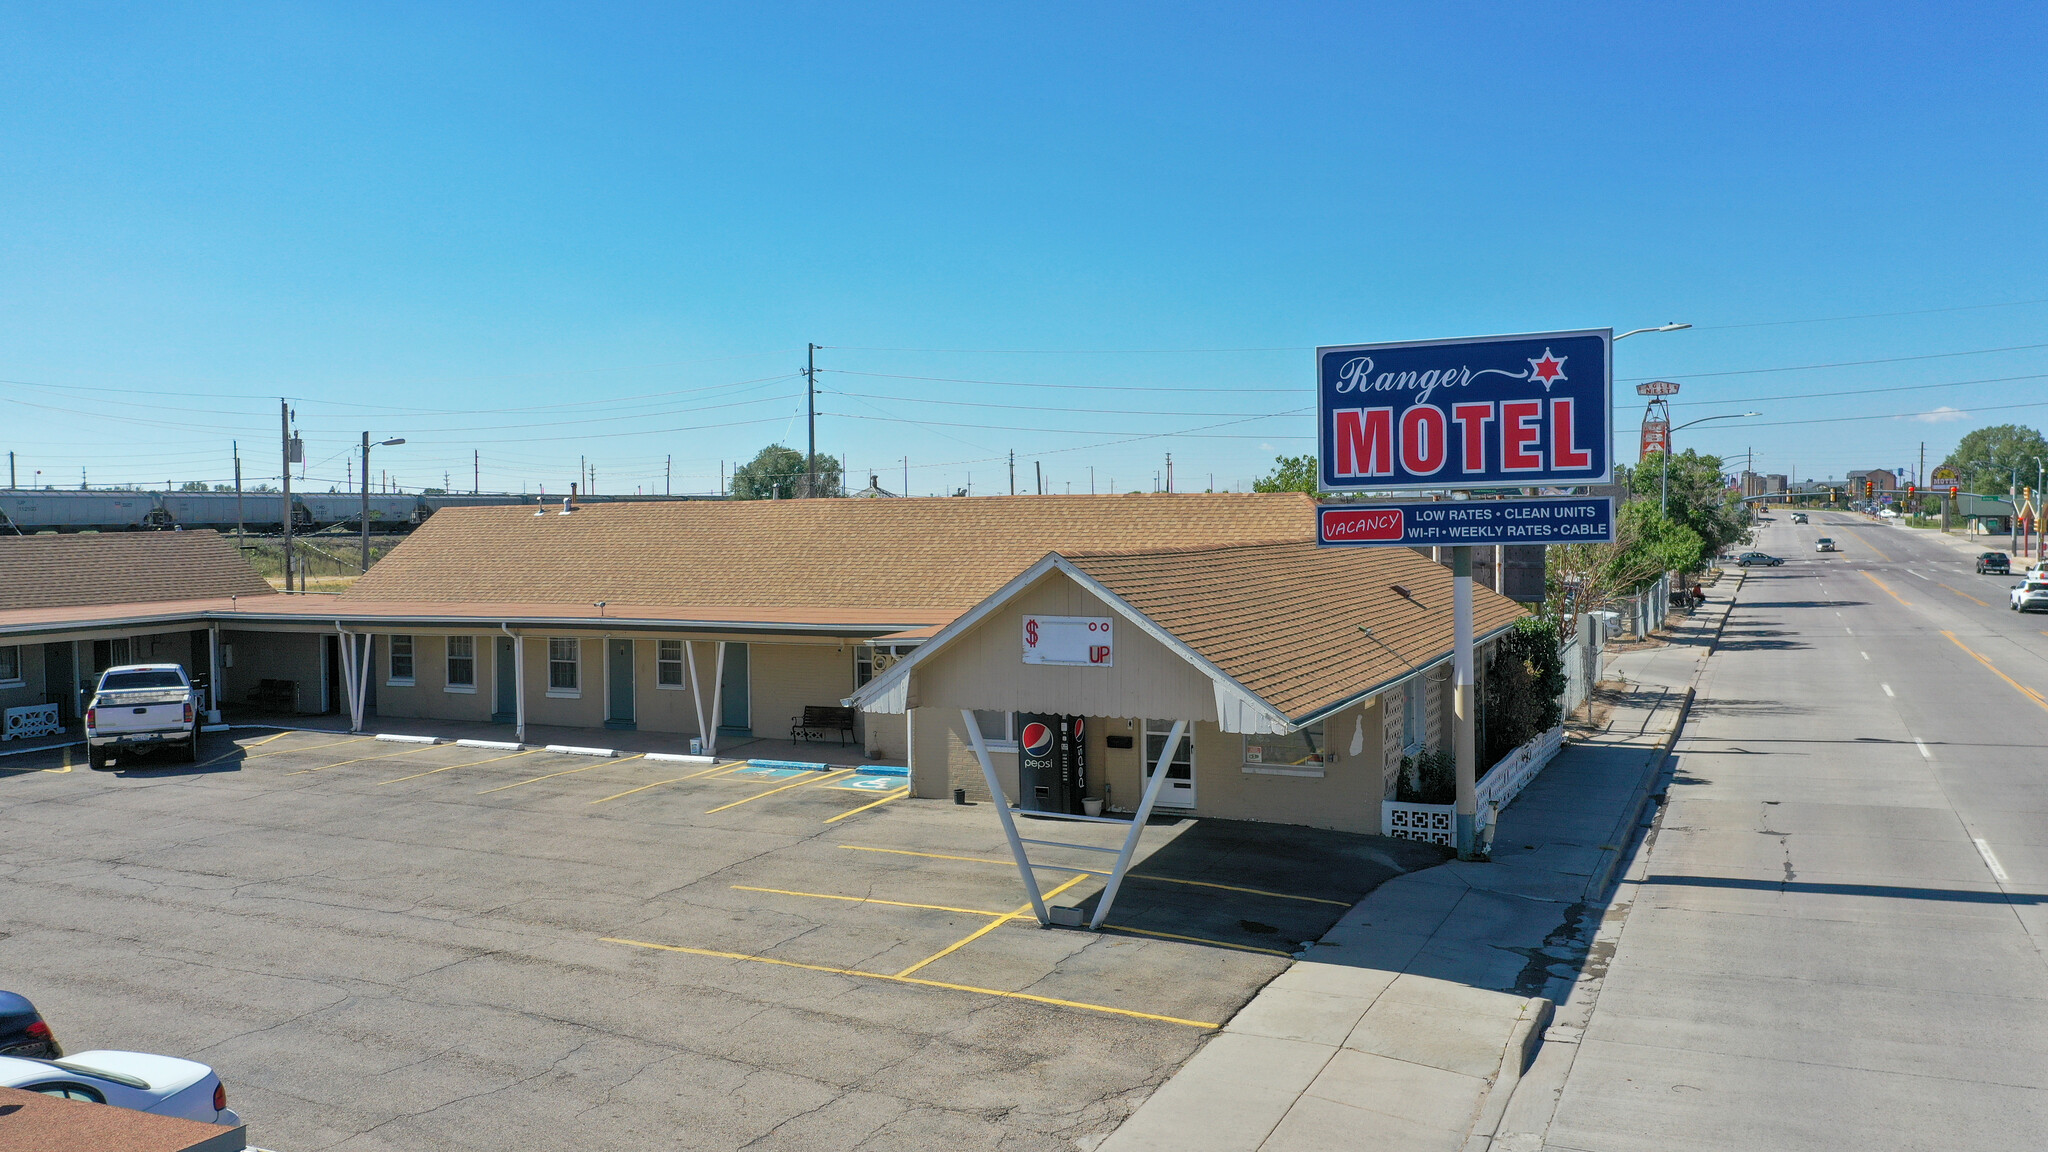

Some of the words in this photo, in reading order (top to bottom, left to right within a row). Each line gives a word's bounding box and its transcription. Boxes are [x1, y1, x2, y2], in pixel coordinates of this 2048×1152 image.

[1336, 356, 1500, 405] Ranger
[1332, 397, 1592, 478] MOTEL
[1325, 513, 1400, 538] VACANCY
[1416, 509, 1446, 522] LOW
[1449, 508, 1492, 521] RATES
[1504, 507, 1550, 519] CLEAN
[1554, 506, 1596, 518] UNITS
[1408, 527, 1440, 539] WI-FI
[1448, 525, 1504, 538] WEEKLY
[1507, 524, 1551, 537] RATES
[1560, 523, 1607, 536] CABLE
[1025, 618, 1039, 648] $
[1089, 645, 1110, 664] UP
[1024, 758, 1053, 770] pepsi
[1076, 745, 1085, 789] pepsi
